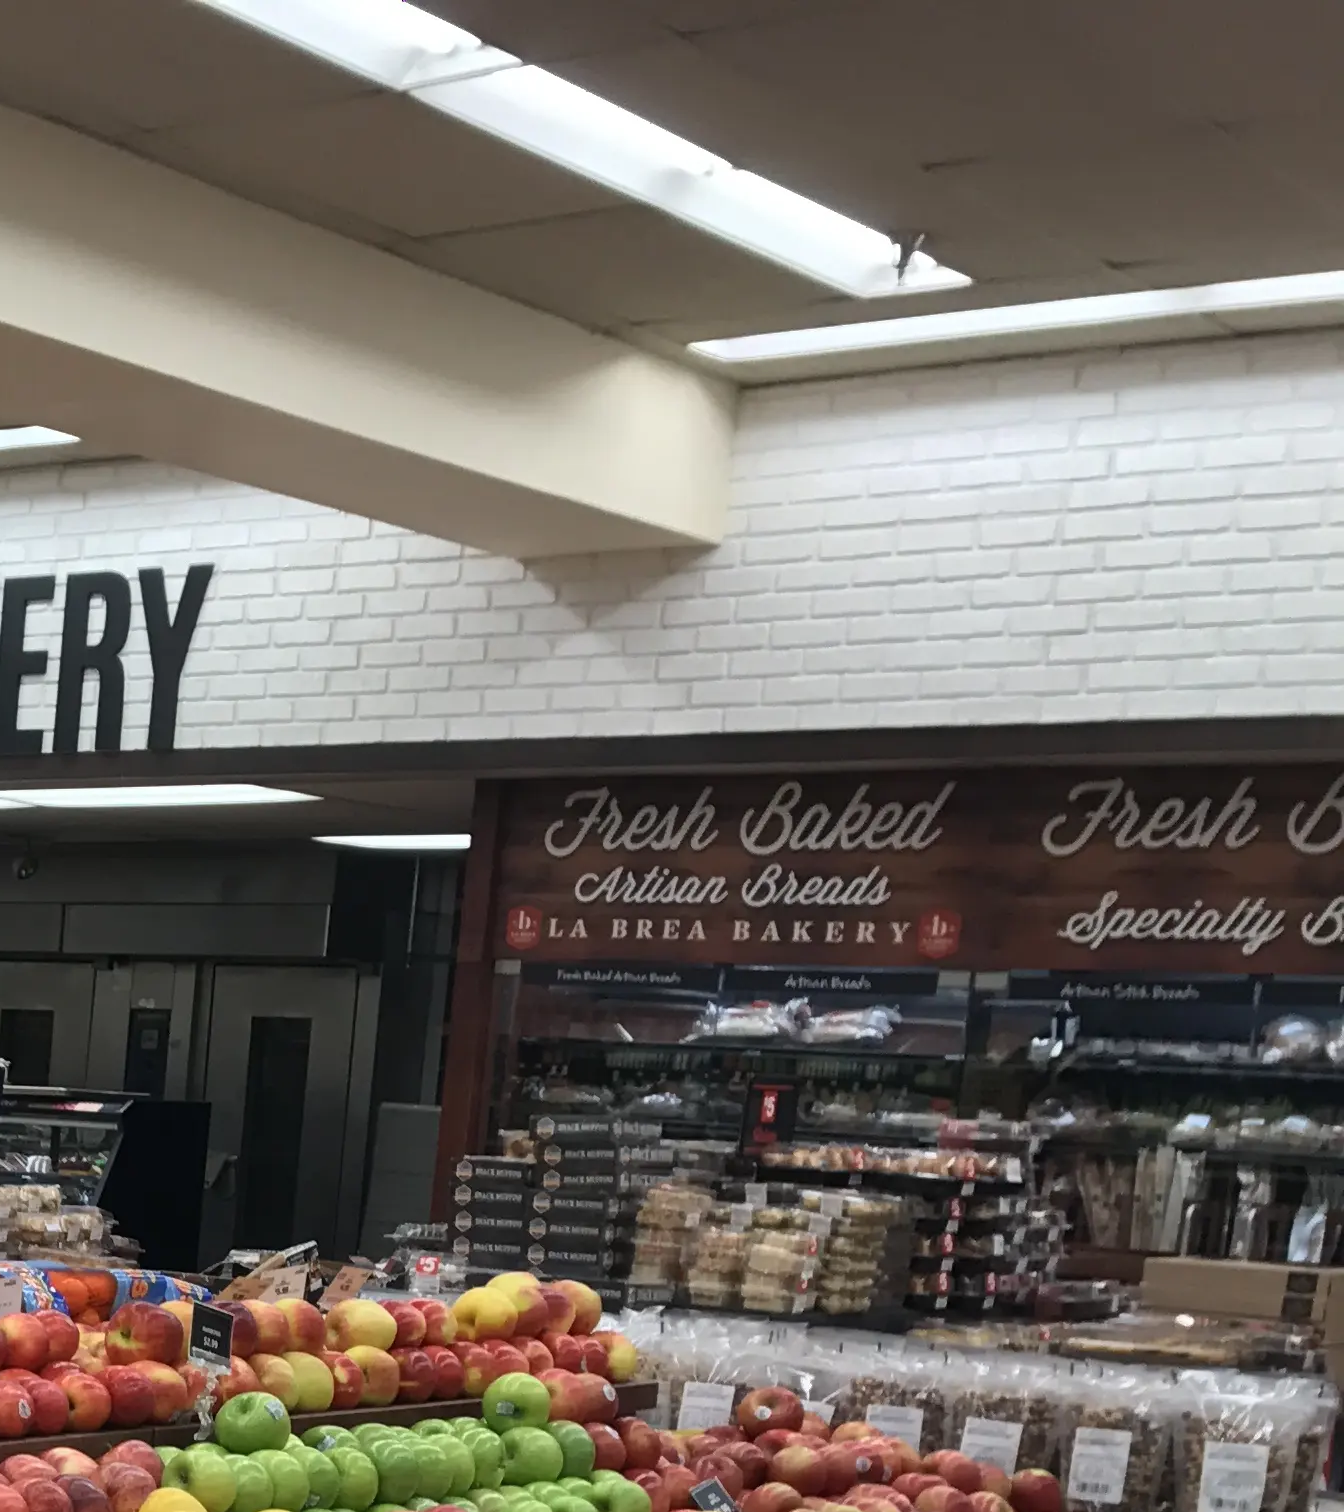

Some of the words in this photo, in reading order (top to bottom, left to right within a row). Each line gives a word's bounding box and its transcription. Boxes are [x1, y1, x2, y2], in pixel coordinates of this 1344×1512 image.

[545, 785, 719, 857] Fresh
[740, 780, 957, 855] Baked
[1041, 777, 1261, 856] Fresh
[575, 865, 728, 904] Artisan
[741, 863, 890, 907] Breads
[548, 917, 588, 939] LA
[612, 918, 708, 941] BREA
[733, 920, 912, 944] BAKERY
[1057, 890, 1286, 957] Specialty
